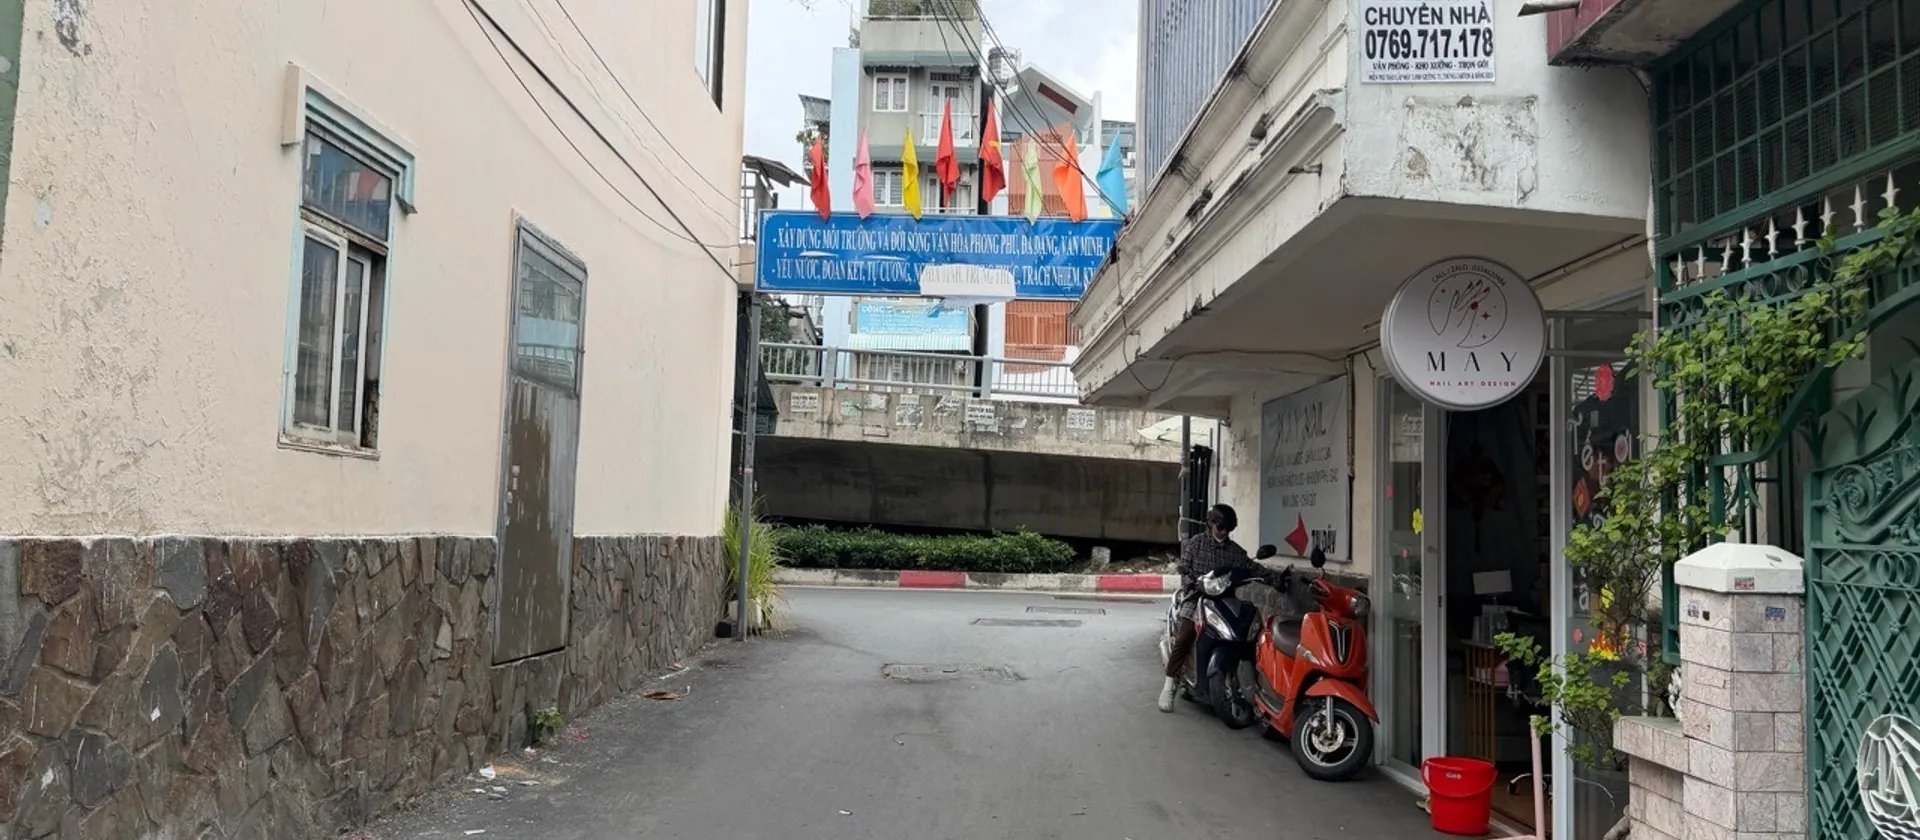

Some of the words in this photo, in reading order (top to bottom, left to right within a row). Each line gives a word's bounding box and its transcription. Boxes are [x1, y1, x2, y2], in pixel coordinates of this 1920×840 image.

[1364, 2, 1444, 26] CHUYỂN
[1449, 1, 1492, 25] NHÀ
[1365, 28, 1493, 59] 0769.717.178
[822, 223, 840, 250] MÔI
[970, 232, 1000, 255] PHONG
[1022, 259, 1051, 286] TRÁCH
[1427, 351, 1518, 372] MAY
